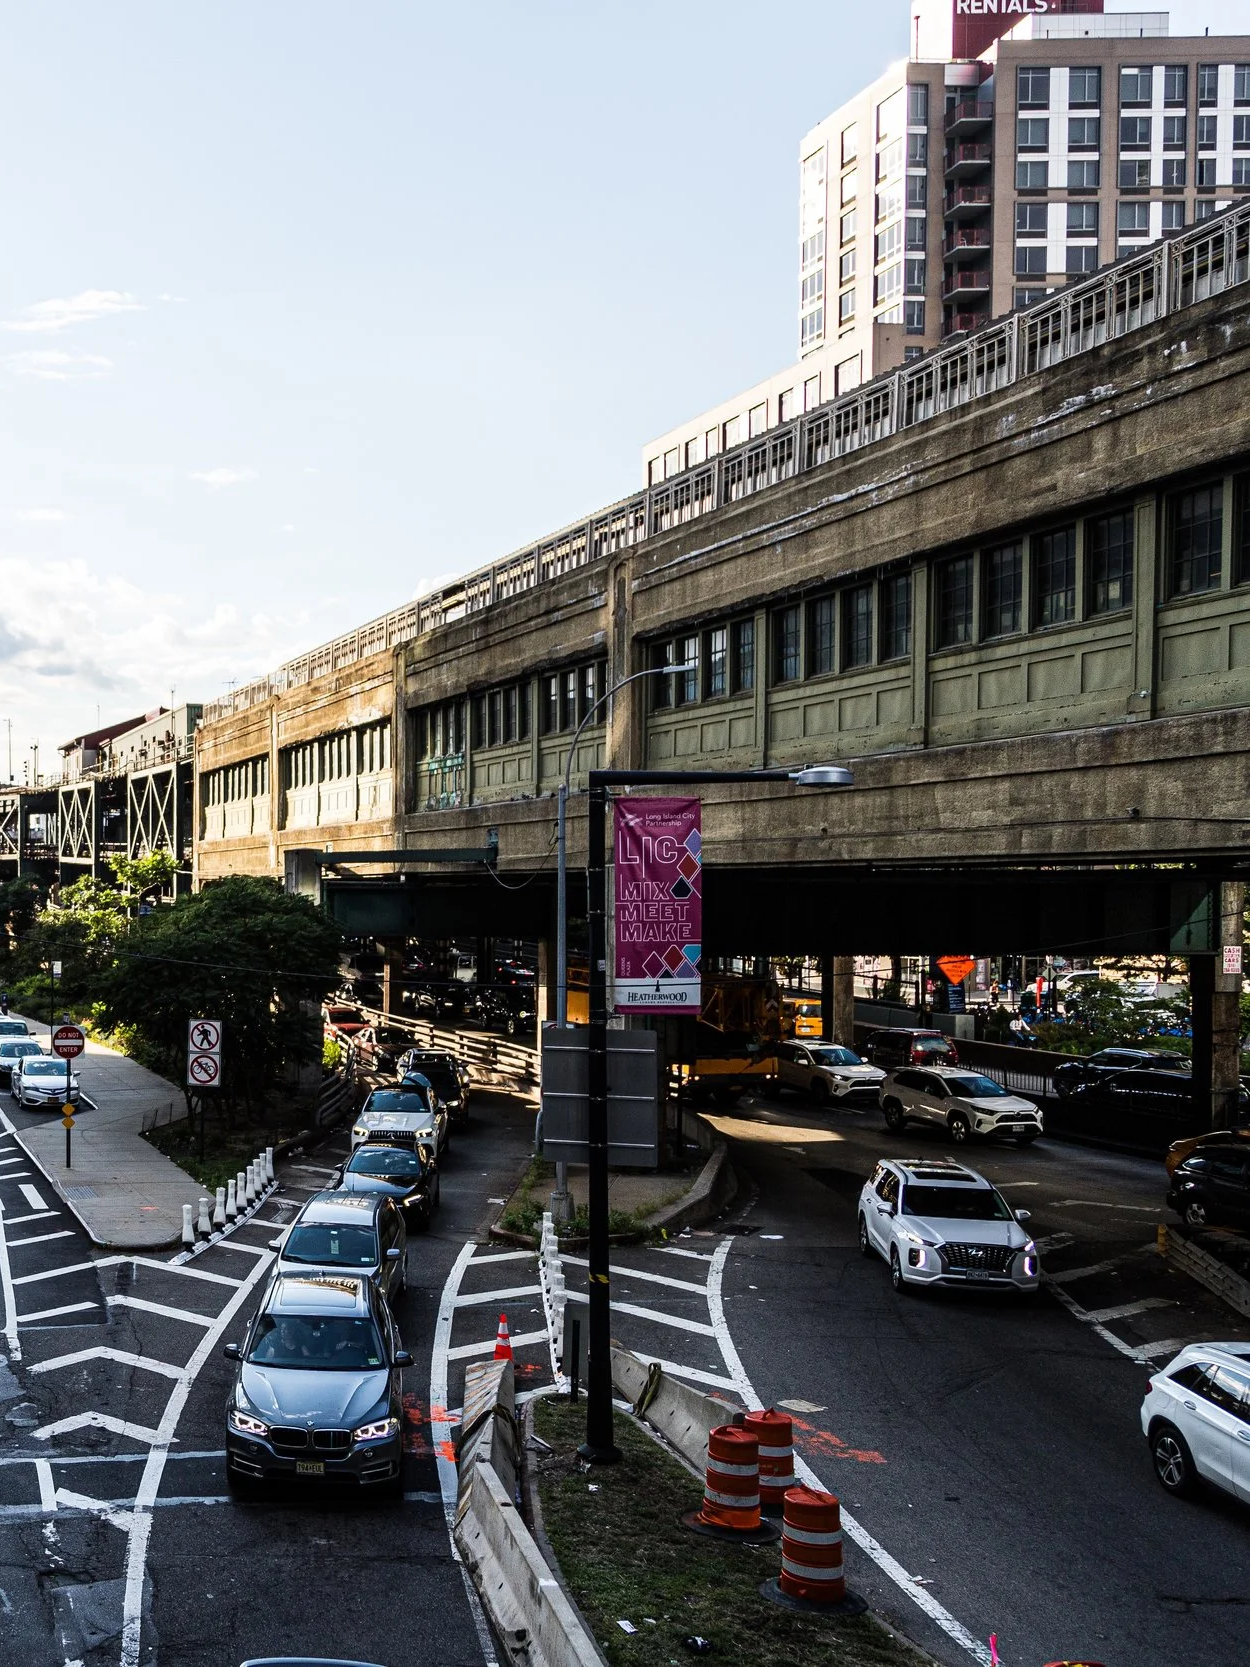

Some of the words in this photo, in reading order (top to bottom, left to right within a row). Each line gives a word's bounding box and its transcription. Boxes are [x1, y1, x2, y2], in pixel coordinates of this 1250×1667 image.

[645, 812, 661, 820] Long
[682, 811, 695, 820] City
[645, 819, 682, 827] Partnership
[619, 831, 678, 877] LIC
[620, 874, 670, 901] MIX
[617, 902, 690, 922] MEET
[620, 922, 693, 943] MAKE
[627, 991, 688, 1003] HEATHERWOOD
